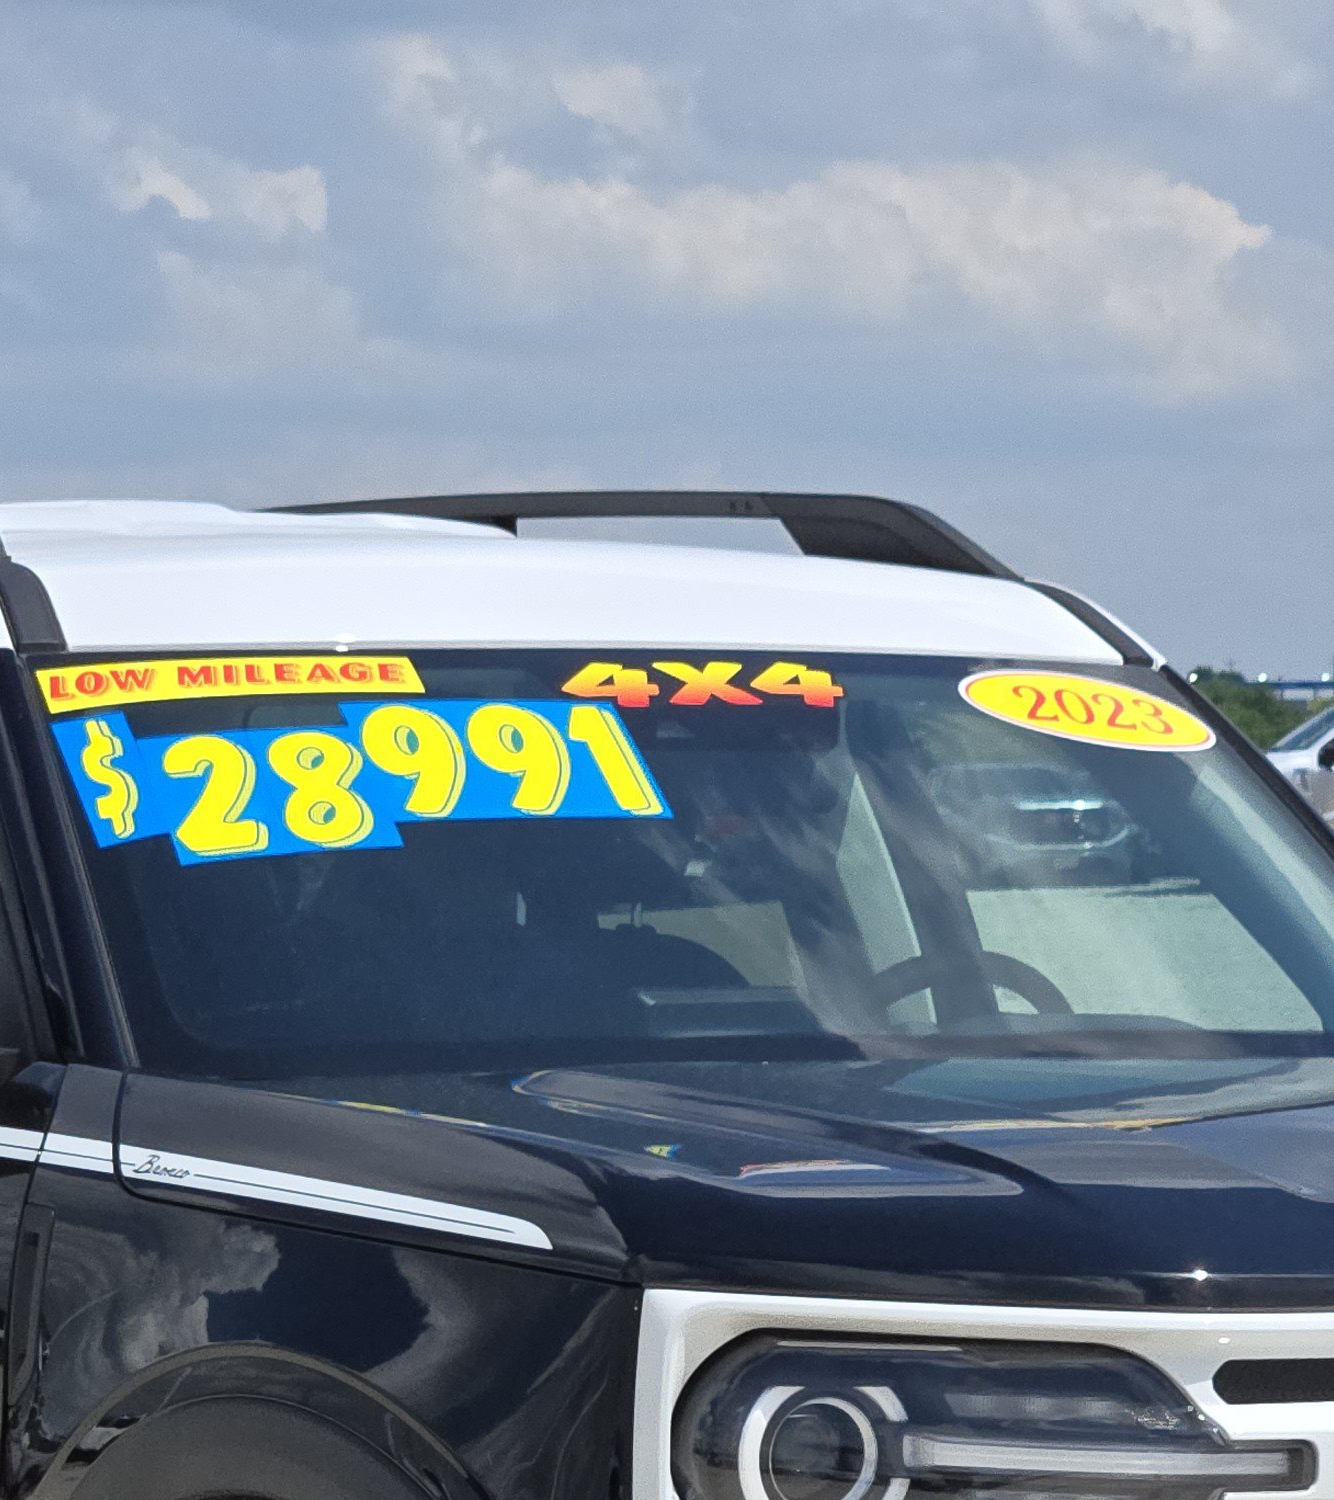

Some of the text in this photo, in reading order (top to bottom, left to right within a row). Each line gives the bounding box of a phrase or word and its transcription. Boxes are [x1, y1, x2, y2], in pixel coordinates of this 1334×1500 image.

[50, 662, 405, 700] LOW MILEAGE
[1012, 685, 1173, 734] 2023
